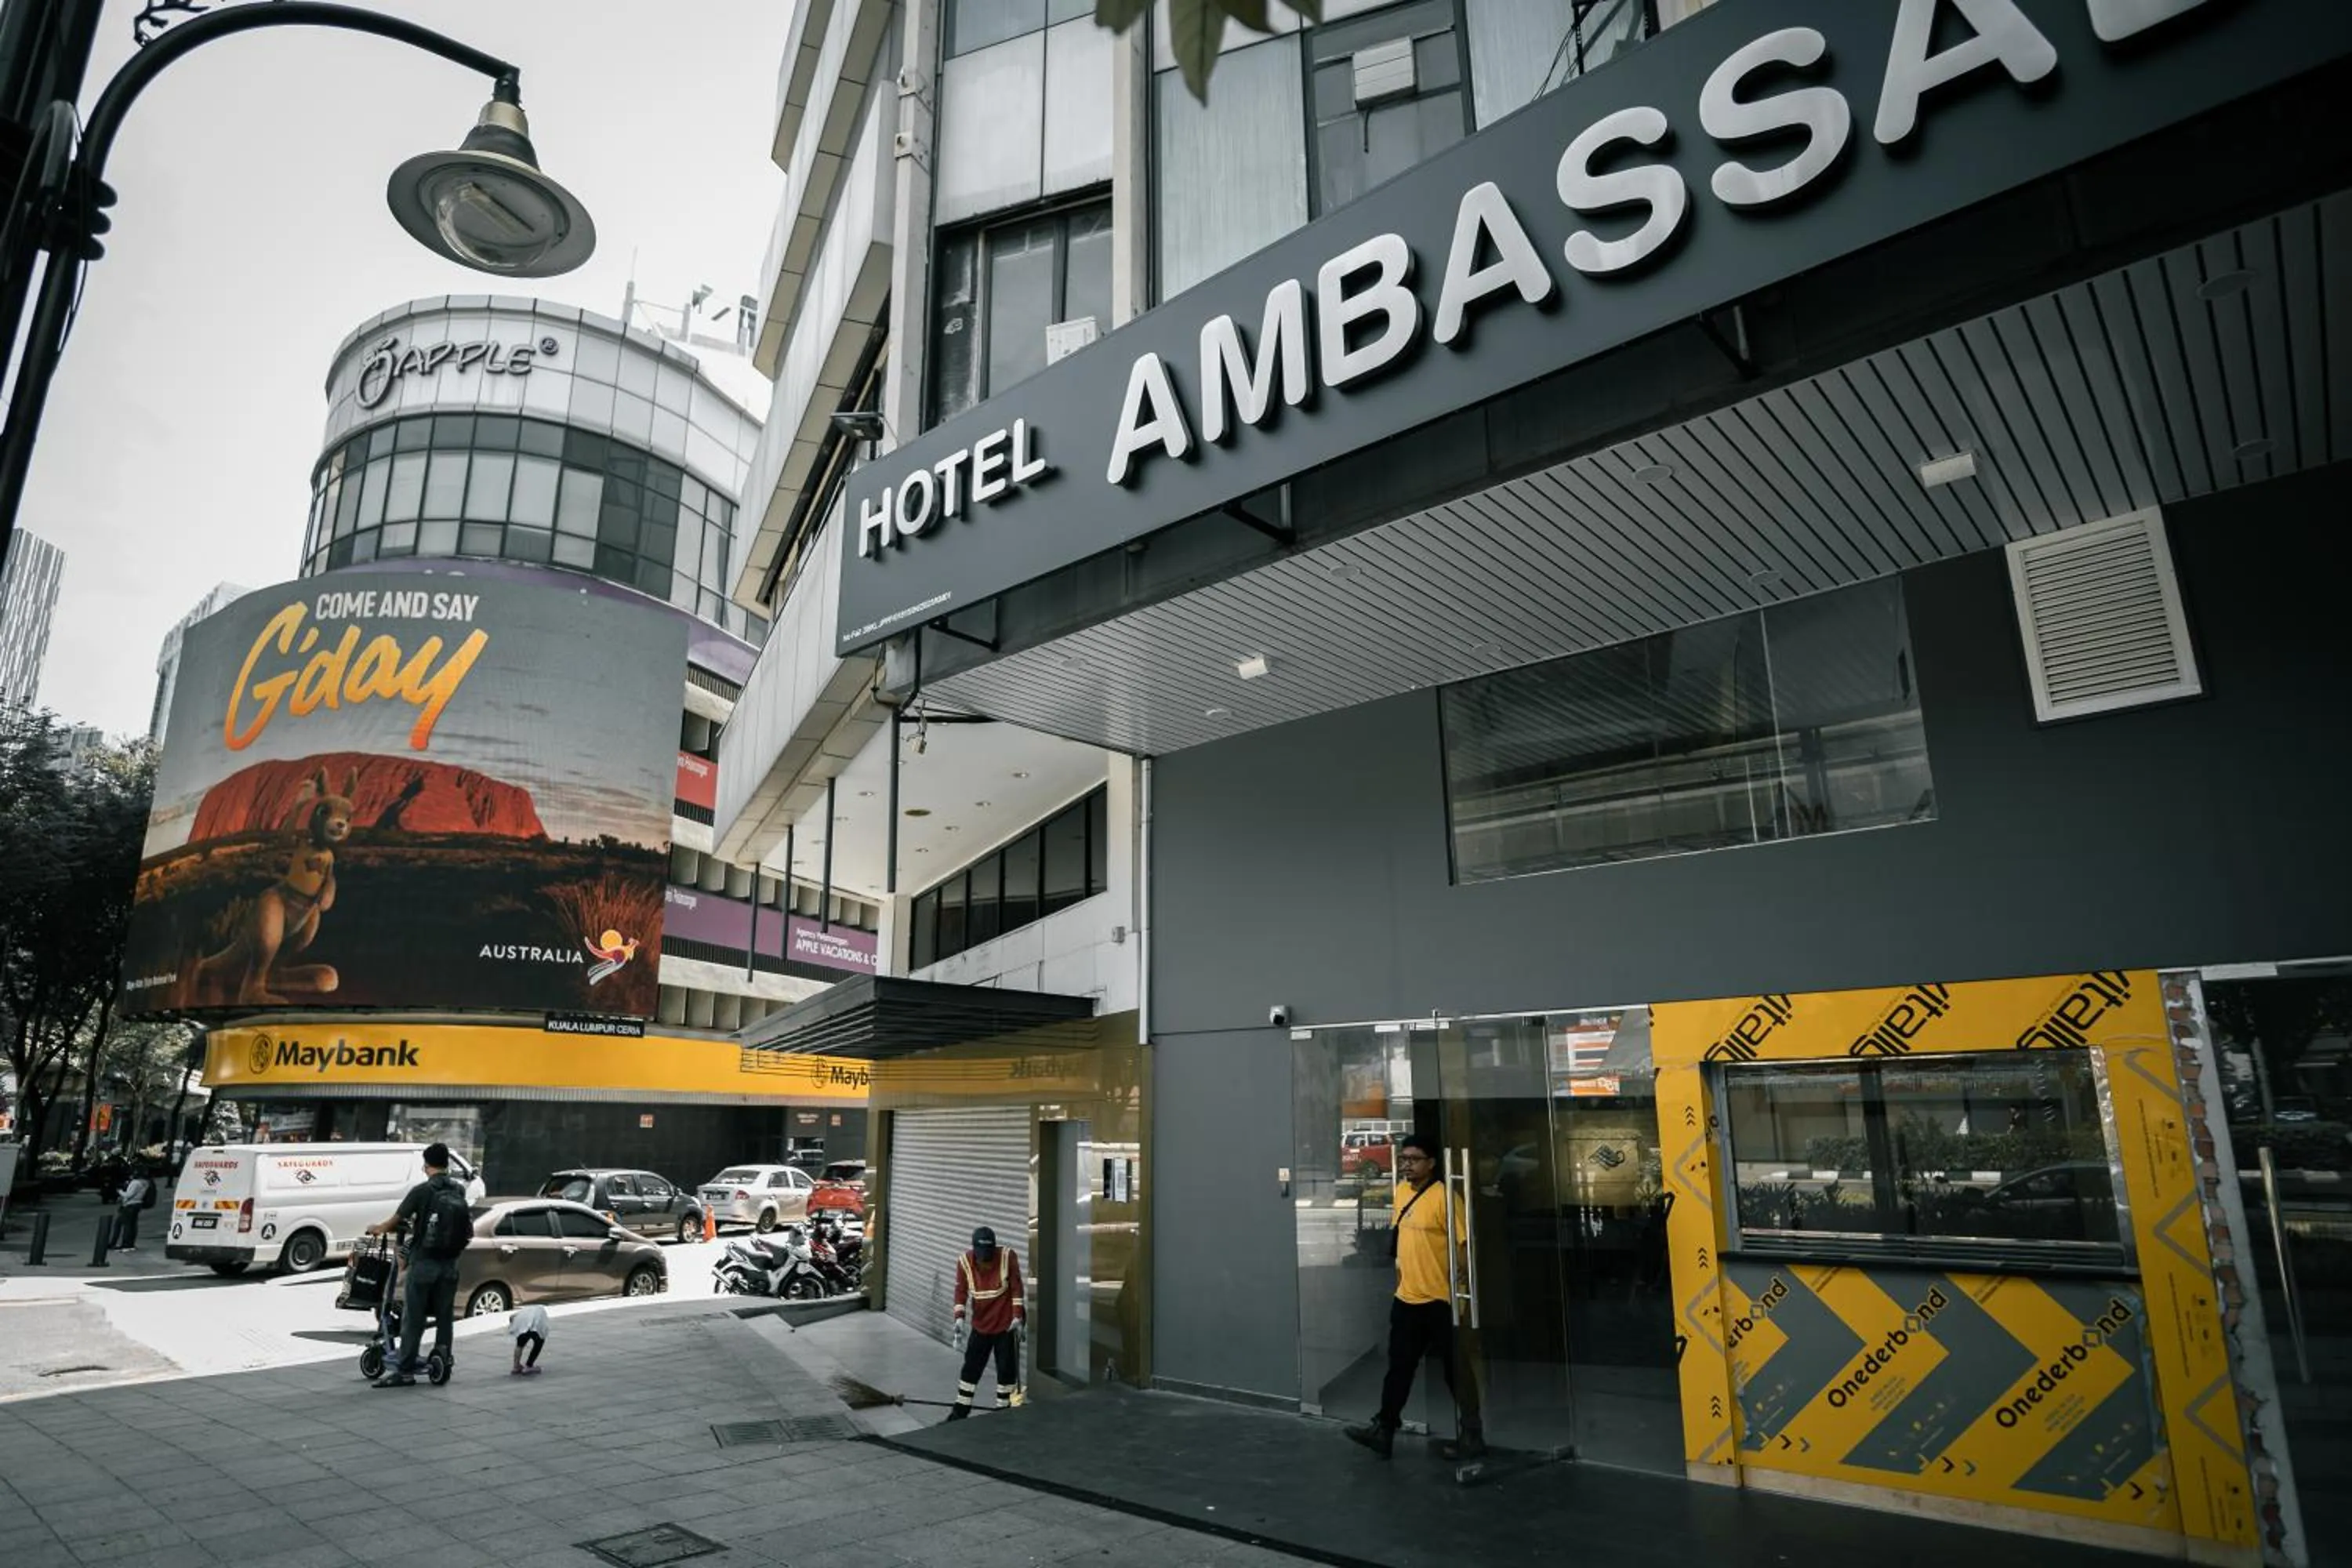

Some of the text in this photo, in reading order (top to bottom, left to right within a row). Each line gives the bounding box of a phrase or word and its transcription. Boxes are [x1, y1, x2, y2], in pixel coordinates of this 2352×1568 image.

[859, 0, 2207, 558] HOTEL AMBASSA
[394, 341, 536, 377] APPLE
[315, 591, 480, 622] COME AND SAY
[224, 601, 488, 750] G'day
[479, 944, 584, 964] AUSTRALIA
[796, 938, 818, 953] APPLE
[820, 943, 862, 964] VACATIONS
[549, 1020, 579, 1031] KUALA
[580, 1022, 615, 1034] LUMPUR
[275, 1039, 419, 1073] Maybank
[1828, 1288, 1947, 1408] Onederbond
[1995, 1299, 2132, 1428] Onederbond
